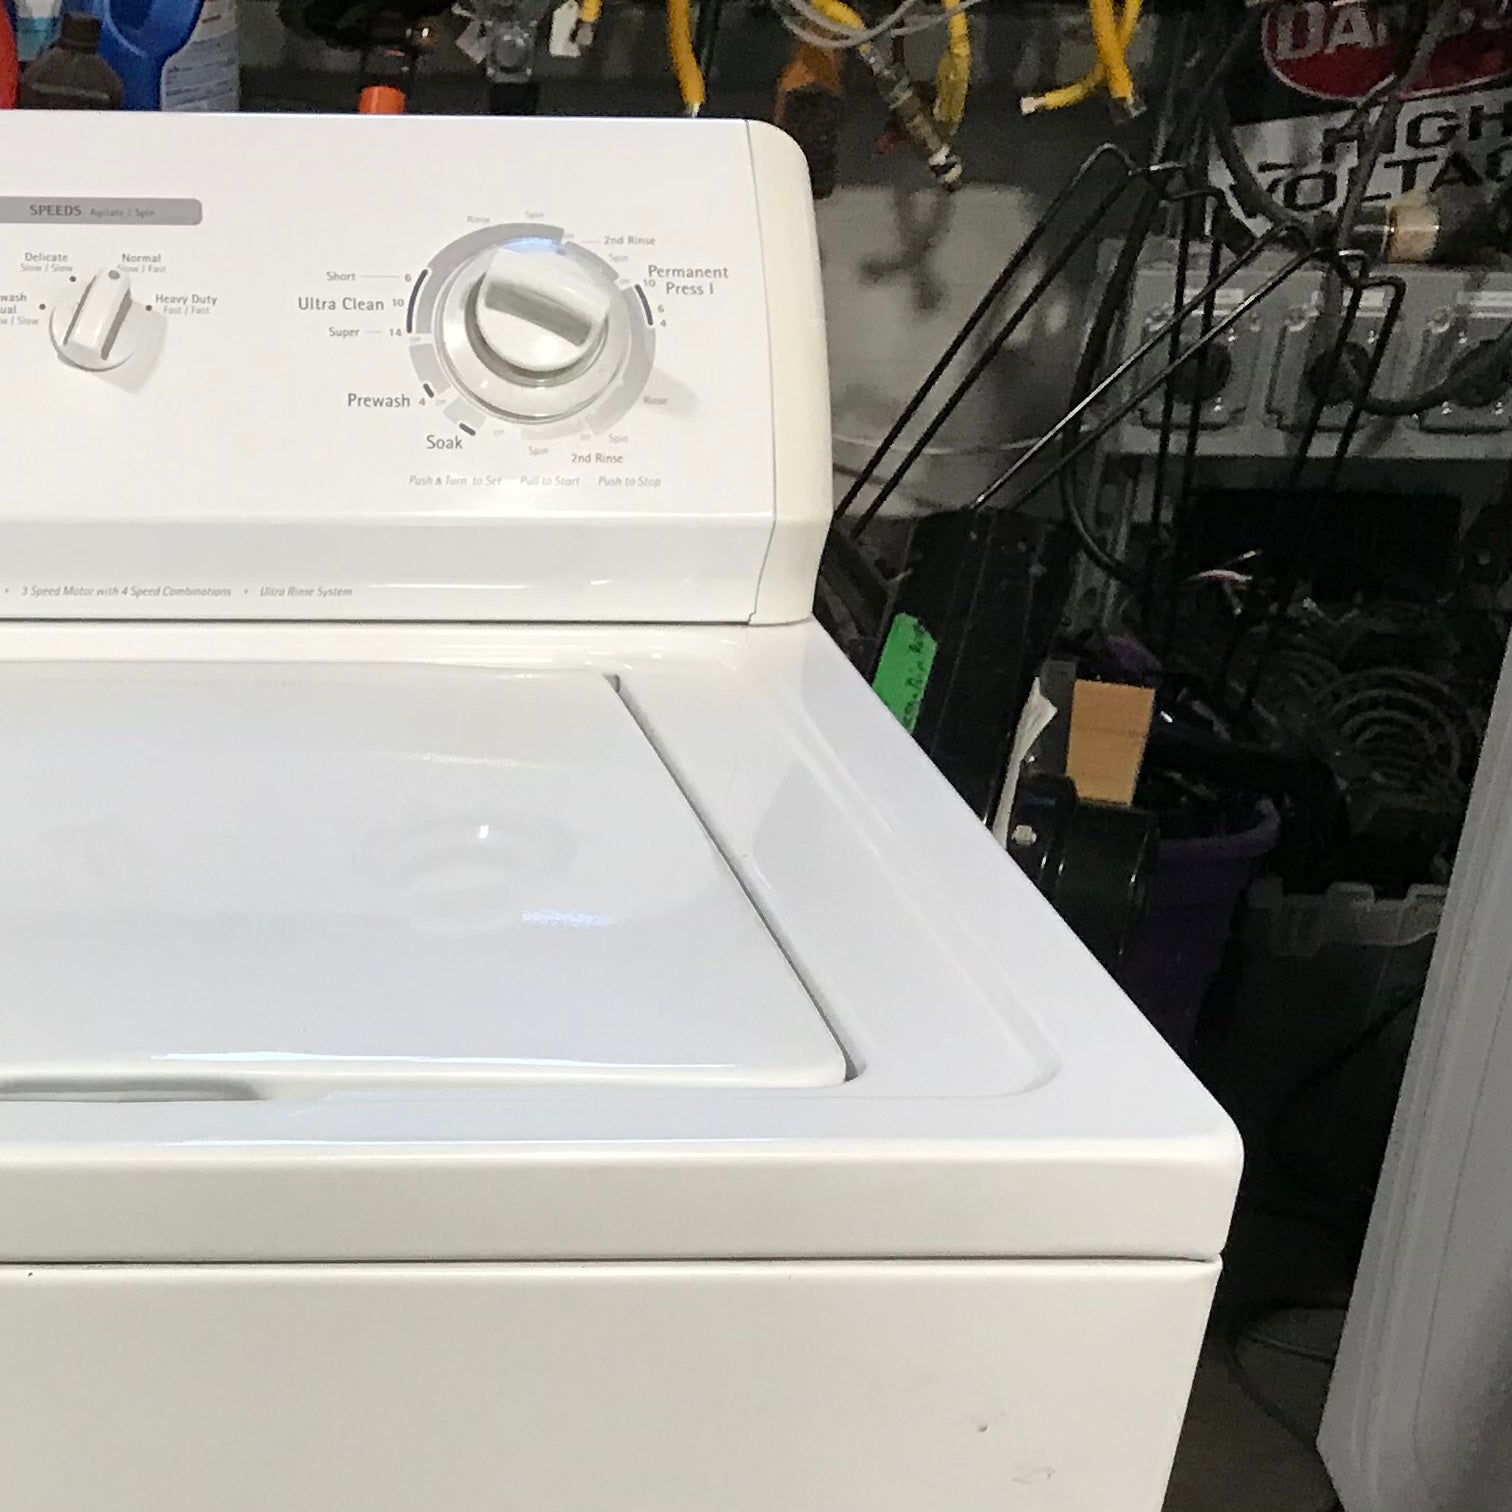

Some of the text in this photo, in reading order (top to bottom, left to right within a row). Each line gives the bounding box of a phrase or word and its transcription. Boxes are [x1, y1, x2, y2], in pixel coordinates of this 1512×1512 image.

[29, 204, 82, 217] SPEEDS
[604, 236, 656, 246] 2nd Rinse
[25, 252, 68, 262] Delicate
[122, 253, 161, 263] Normal
[20, 263, 42, 272] Slow
[51, 264, 73, 273] Slow
[148, 264, 167, 273] Fast
[648, 264, 729, 279] Permanent
[326, 271, 356, 281] Short
[404, 273, 412, 282] 6
[643, 279, 656, 288] 10
[665, 281, 703, 296] Press
[155, 294, 218, 306] Heavy Duty
[297, 297, 384, 311] Ultra Clean
[392, 298, 405, 307] 10
[163, 305, 182, 314] Fast
[191, 305, 210, 314] Fast
[17, 316, 39, 326] Slow
[328, 327, 360, 339] Super
[347, 393, 410, 408] Prewash
[418, 396, 426, 406] 4
[426, 435, 463, 450] Soak
[571, 453, 624, 464] 2nd Rinse
[408, 475, 433, 486] Push
[445, 475, 468, 486] Turn
[472, 475, 484, 486] to
[485, 475, 503, 487] Set
[520, 475, 580, 487] Pull to Start
[598, 475, 662, 488] Push to Stop
[30, 585, 61, 598] Speed
[62, 585, 95, 597] Motor
[96, 585, 120, 597] with
[130, 585, 161, 598] Speed
[162, 585, 232, 597] Combinations
[259, 586, 353, 598] Ultra Rinse System
